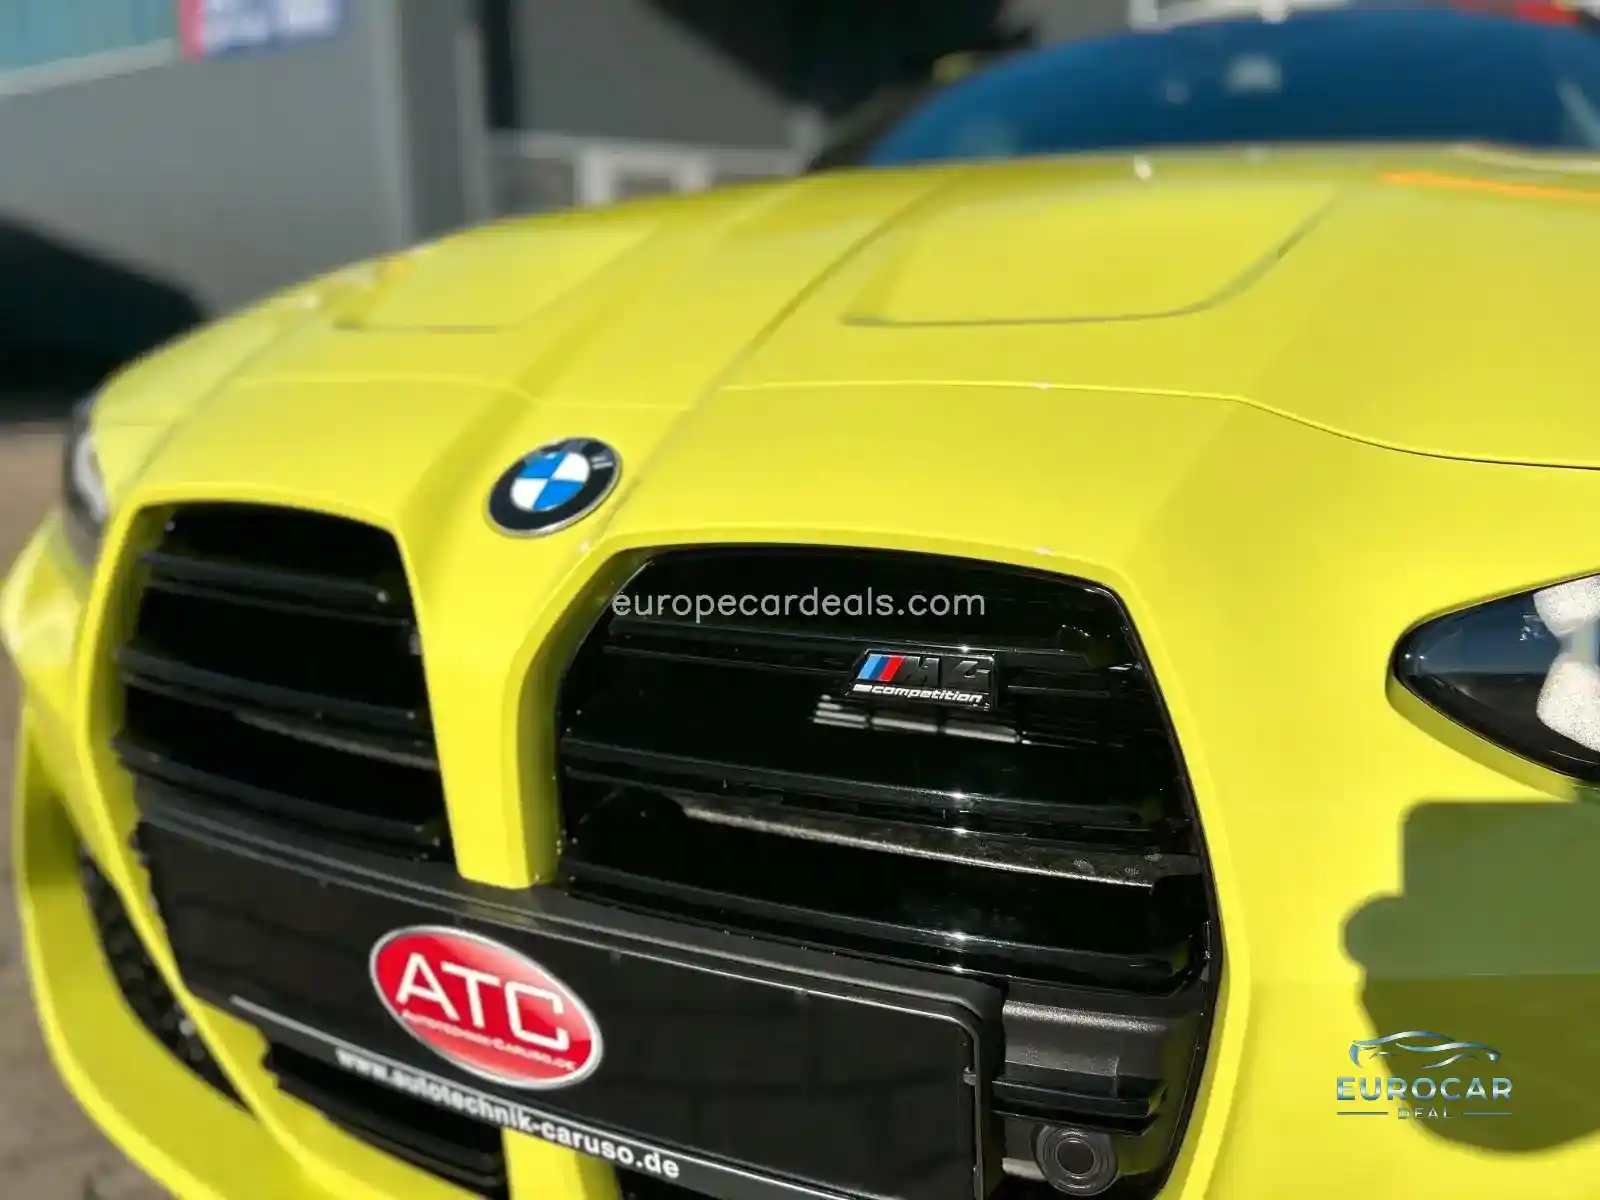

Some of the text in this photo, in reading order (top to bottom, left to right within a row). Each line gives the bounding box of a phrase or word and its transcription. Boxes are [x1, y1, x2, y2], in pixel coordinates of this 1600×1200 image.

[870, 684, 984, 703] competition
[396, 953, 569, 1052] ATC
[335, 1047, 680, 1179] www.autotechnik-caruso.de
